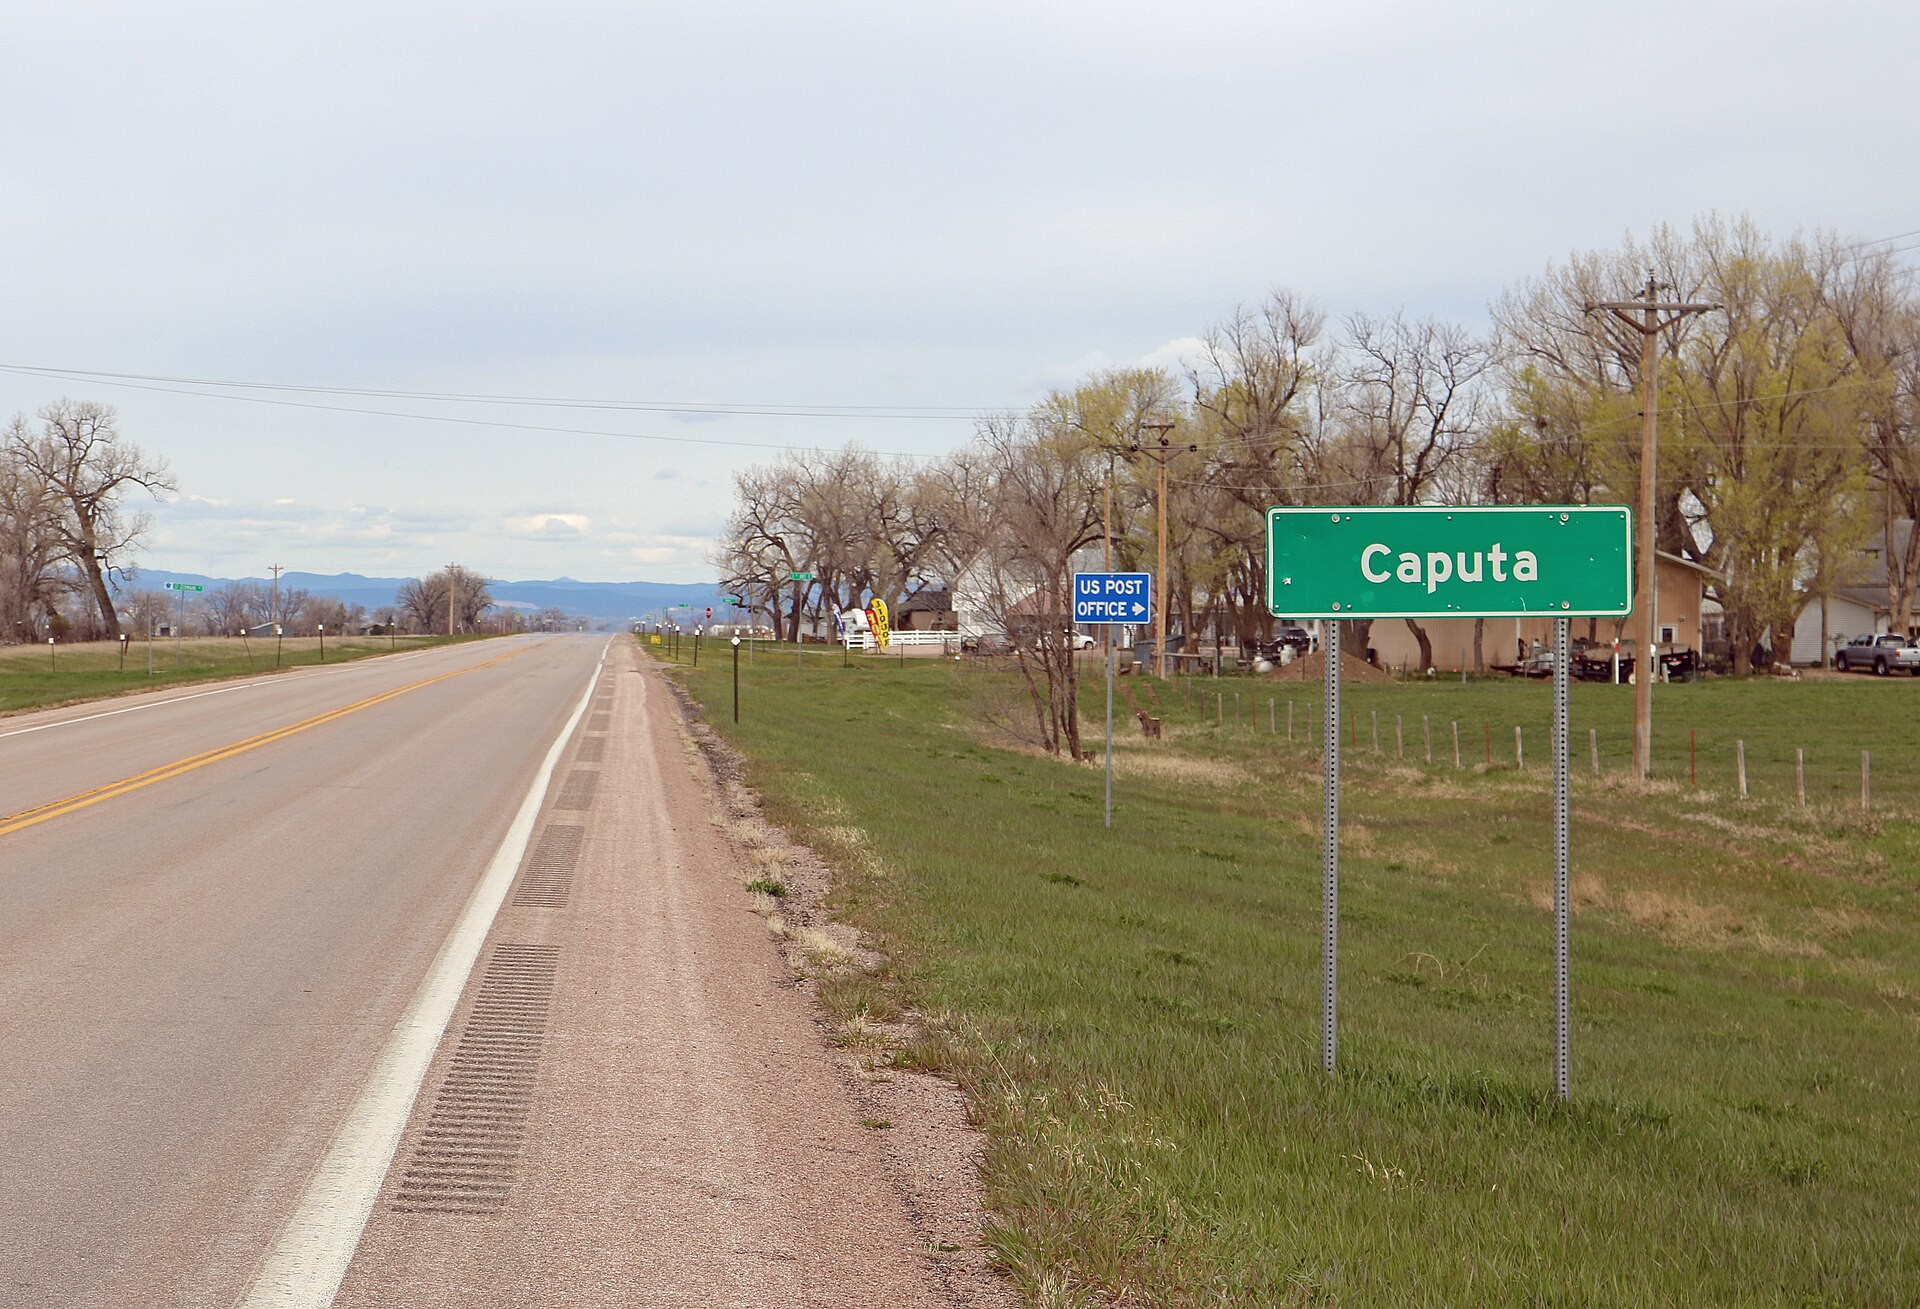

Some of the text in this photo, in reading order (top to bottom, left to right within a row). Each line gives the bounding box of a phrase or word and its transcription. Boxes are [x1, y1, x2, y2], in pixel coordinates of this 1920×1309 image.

[1360, 543, 1538, 595] Caputa
[1080, 580, 1143, 595] US POST
[1077, 601, 1128, 617] OFFICE
